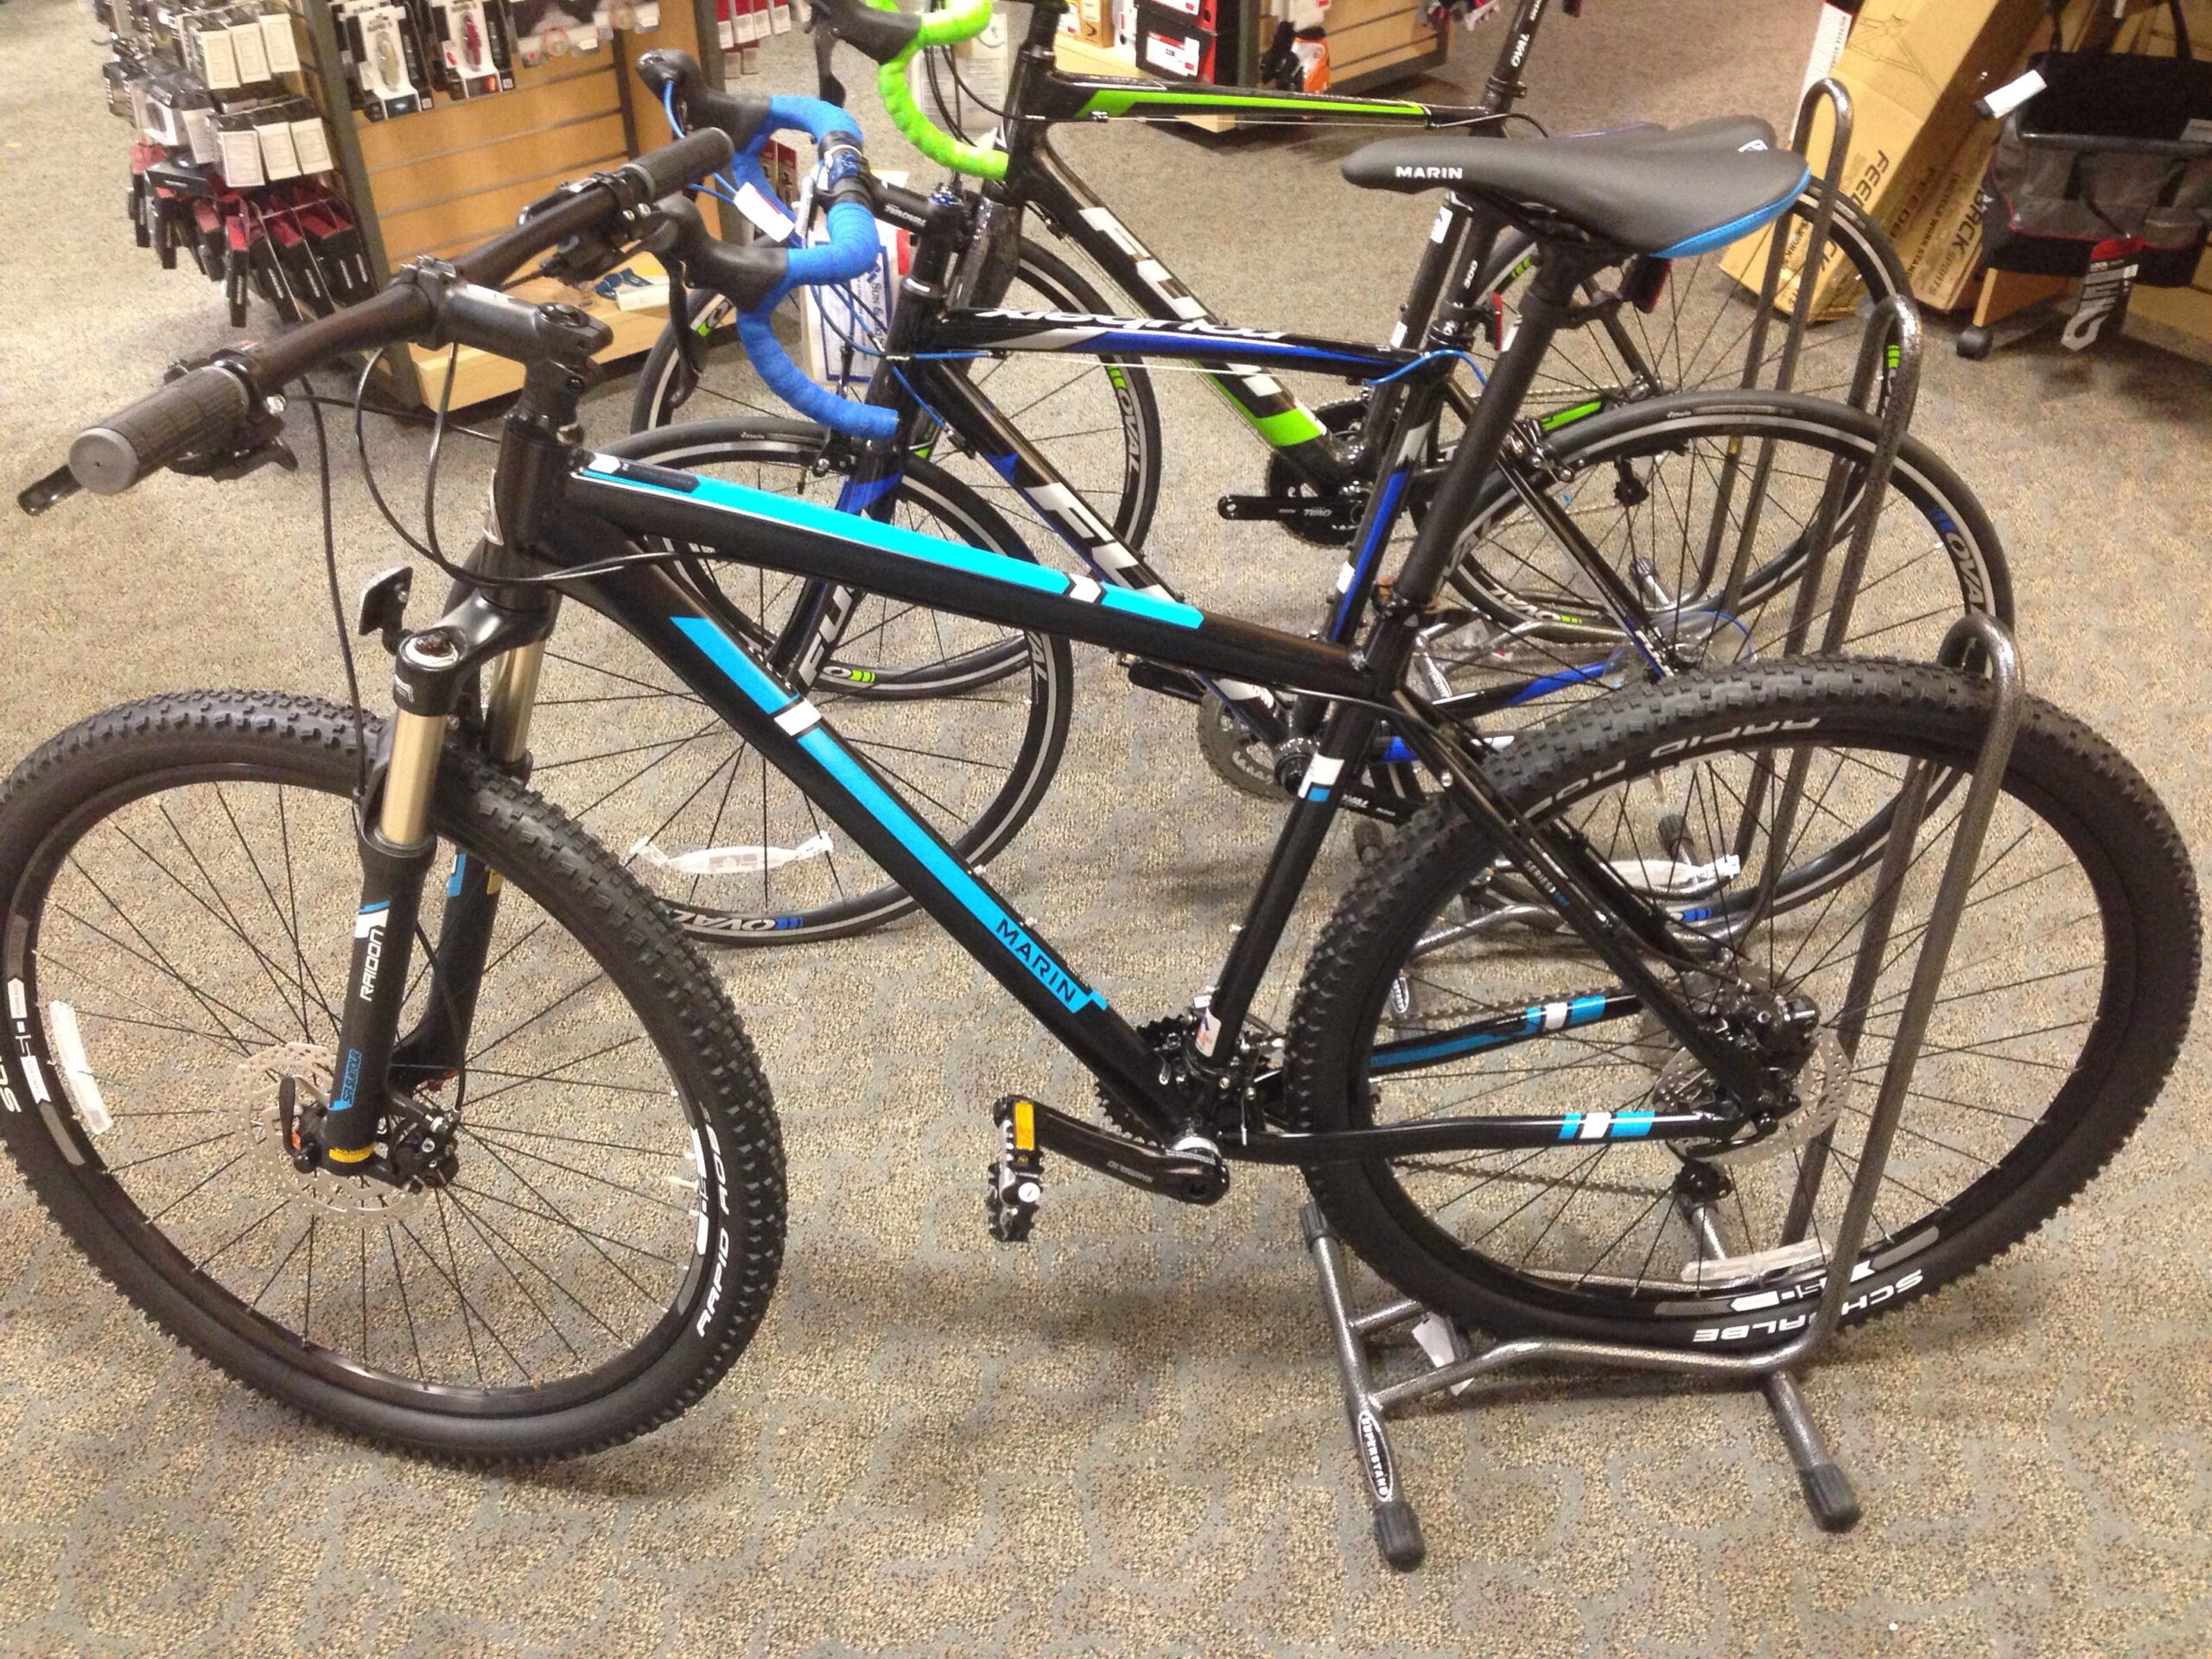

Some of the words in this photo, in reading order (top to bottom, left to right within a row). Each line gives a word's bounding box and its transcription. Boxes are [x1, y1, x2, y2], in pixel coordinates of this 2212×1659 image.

[1395, 166, 1463, 179] MARIN
[1118, 387, 1140, 475] OVAL
[1026, 631, 1048, 688] VAL
[1649, 717, 1821, 758] RAPID
[1524, 860, 1554, 890] SERIES
[670, 909, 777, 931] OVAL
[359, 928, 384, 1001] RAIDON
[996, 918, 1077, 1003] MARIN
[705, 1124, 730, 1216] ROB
[696, 1226, 730, 1338] RAPID
[1693, 1268, 1924, 1343] SCHALBE
[1361, 1417, 1389, 1497] SUPERSTAND
